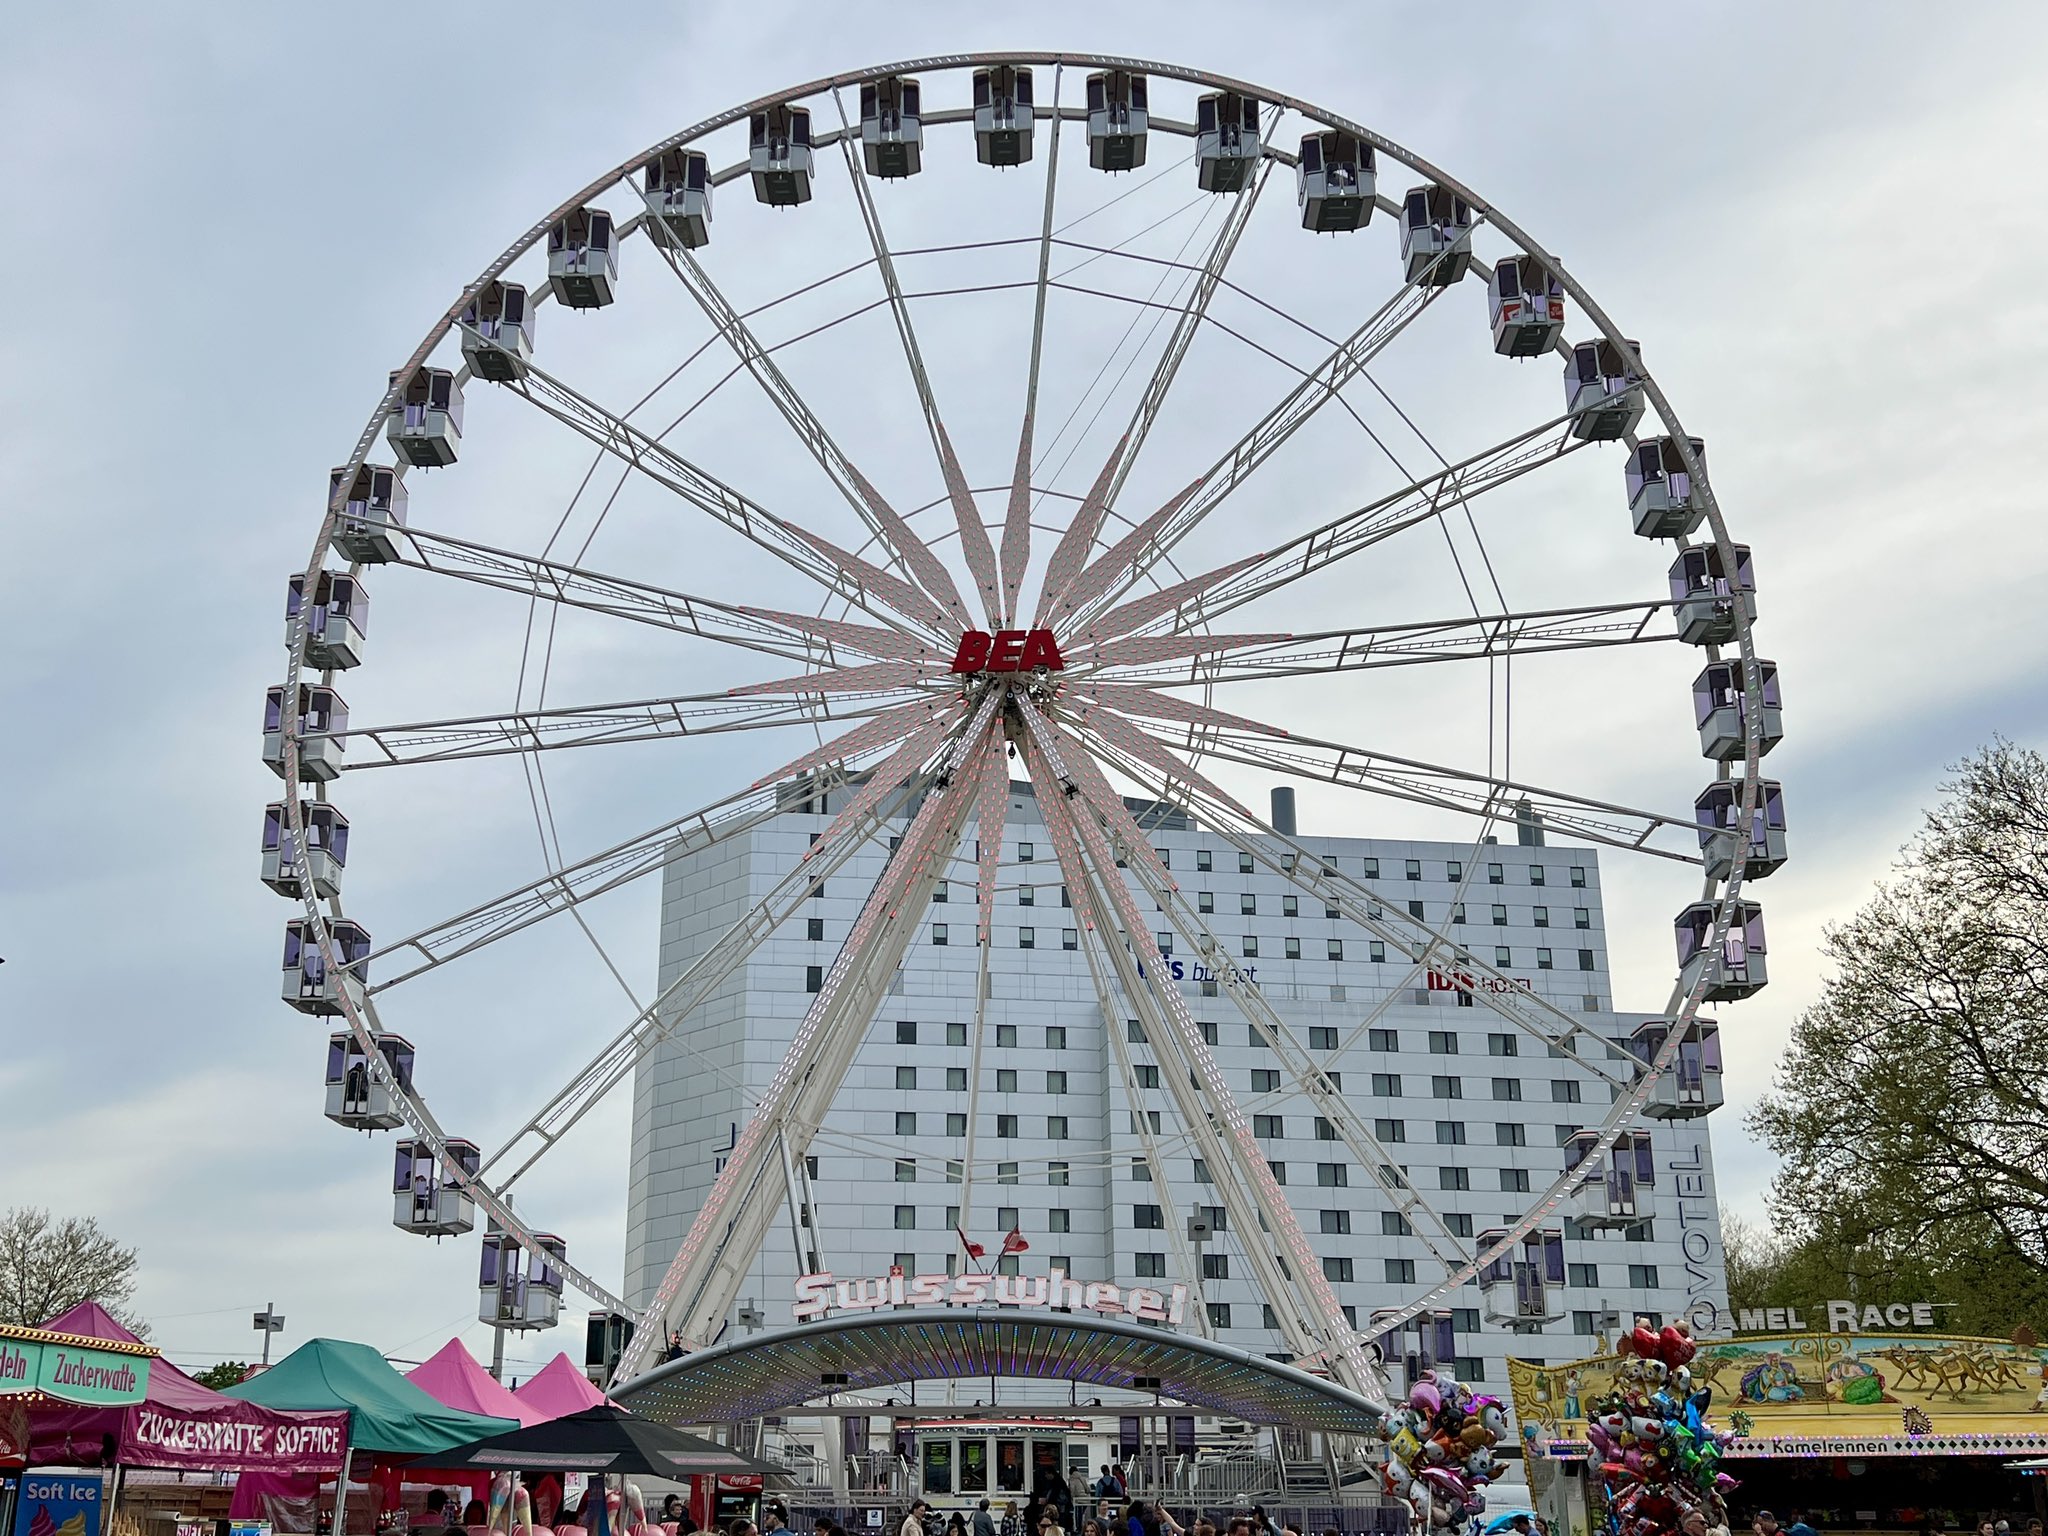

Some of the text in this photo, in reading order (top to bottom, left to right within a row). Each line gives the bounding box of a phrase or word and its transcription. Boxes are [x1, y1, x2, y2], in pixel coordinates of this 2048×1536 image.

[952, 629, 1064, 673] BEA
[792, 1265, 1186, 1325] Swisswheel
[1827, 1300, 1935, 1334] RACE
[53, 1353, 136, 1393] Zuckerwatte
[136, 1411, 265, 1453] ZUCKERWATTE
[1772, 1439, 1888, 1454] Kamelrennen
[27, 1482, 96, 1500] Soft Ice
